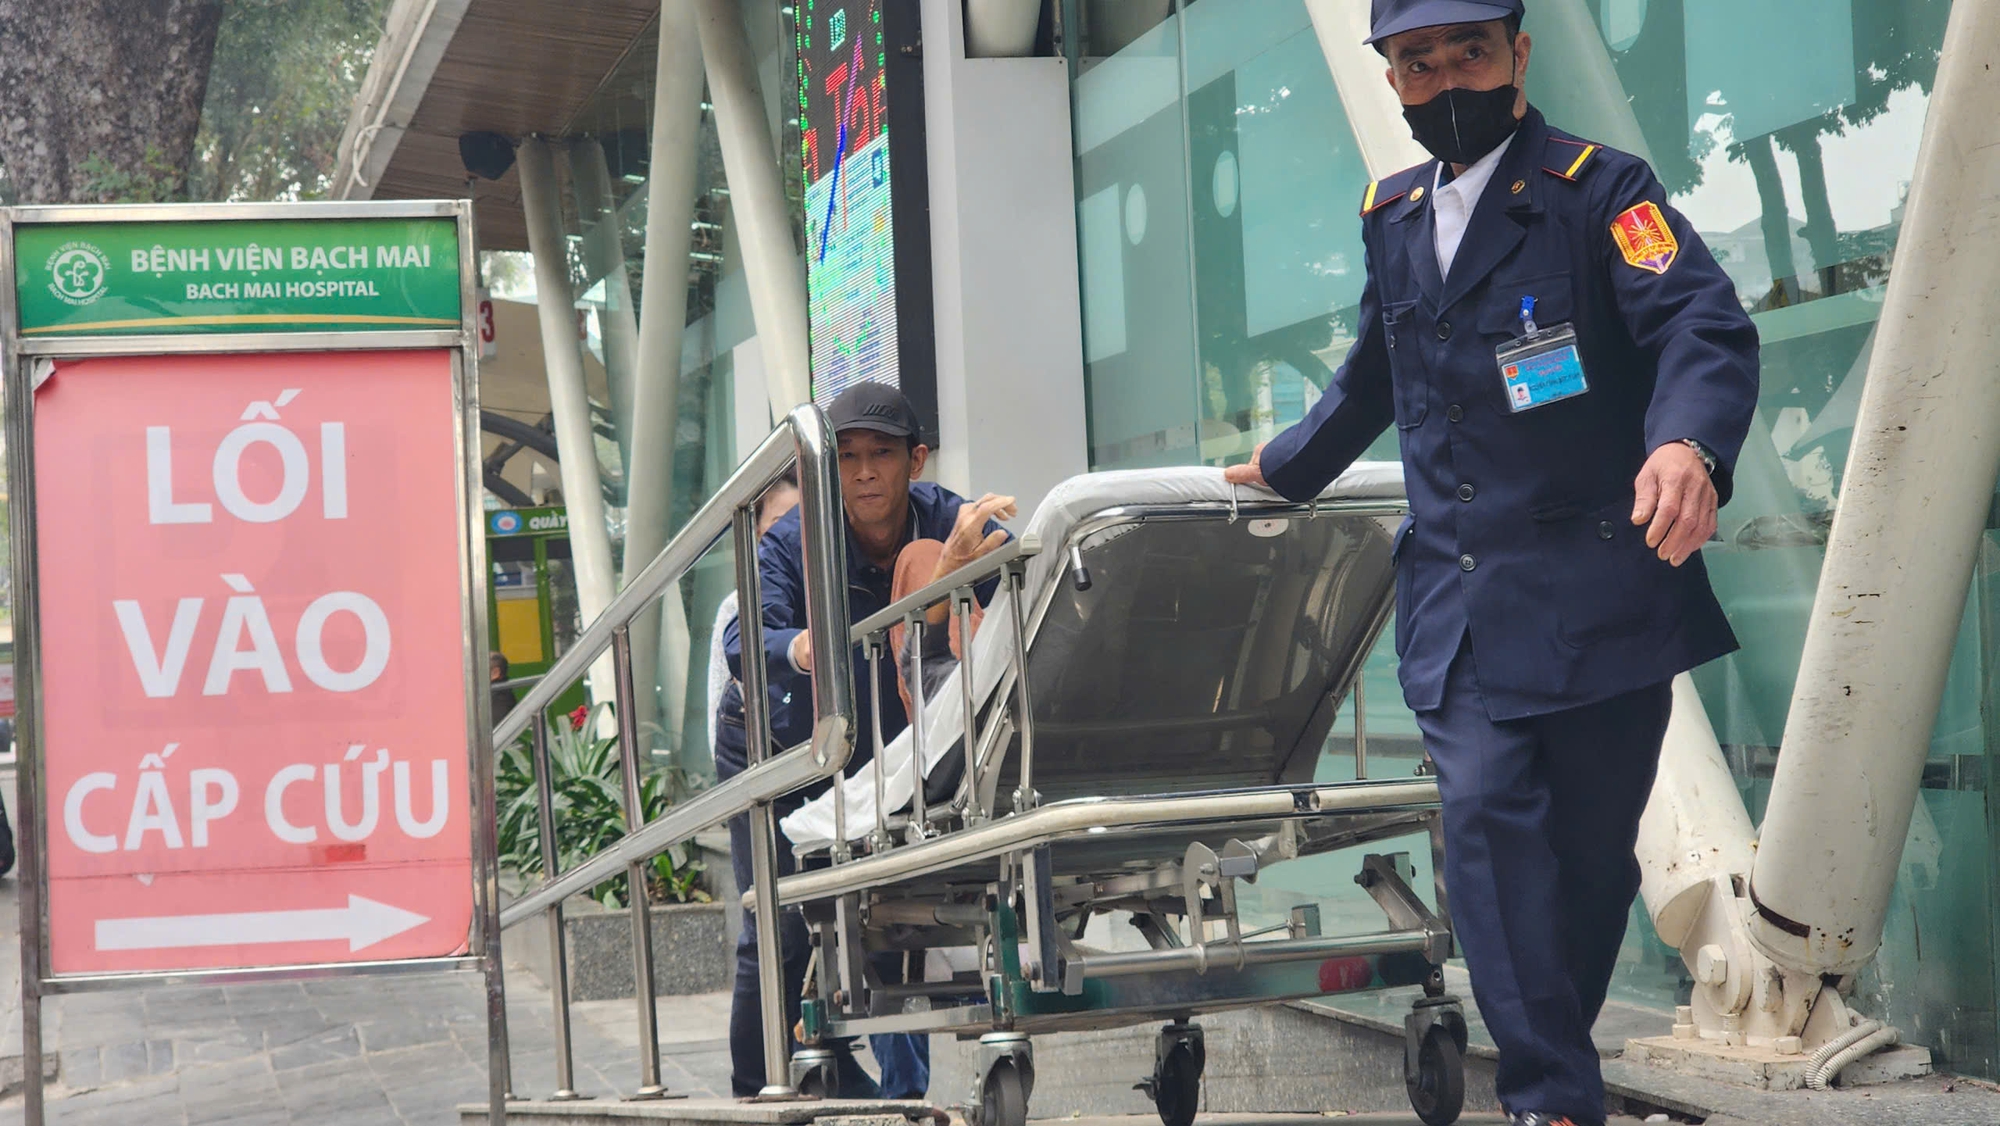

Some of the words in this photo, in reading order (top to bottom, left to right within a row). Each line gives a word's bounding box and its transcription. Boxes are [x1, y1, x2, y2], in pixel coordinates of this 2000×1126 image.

[131, 244, 210, 277] BỆNH
[215, 242, 283, 276] VIỆN
[290, 246, 368, 276] BẠCH
[377, 244, 431, 268] MAI
[186, 283, 239, 300] BACH
[244, 283, 281, 298] MAI
[286, 281, 379, 298] HOSPITAL
[147, 389, 349, 524] LỐI
[113, 574, 391, 697] VÀO
[64, 743, 240, 853] CẤP
[265, 745, 449, 845] CỨU
